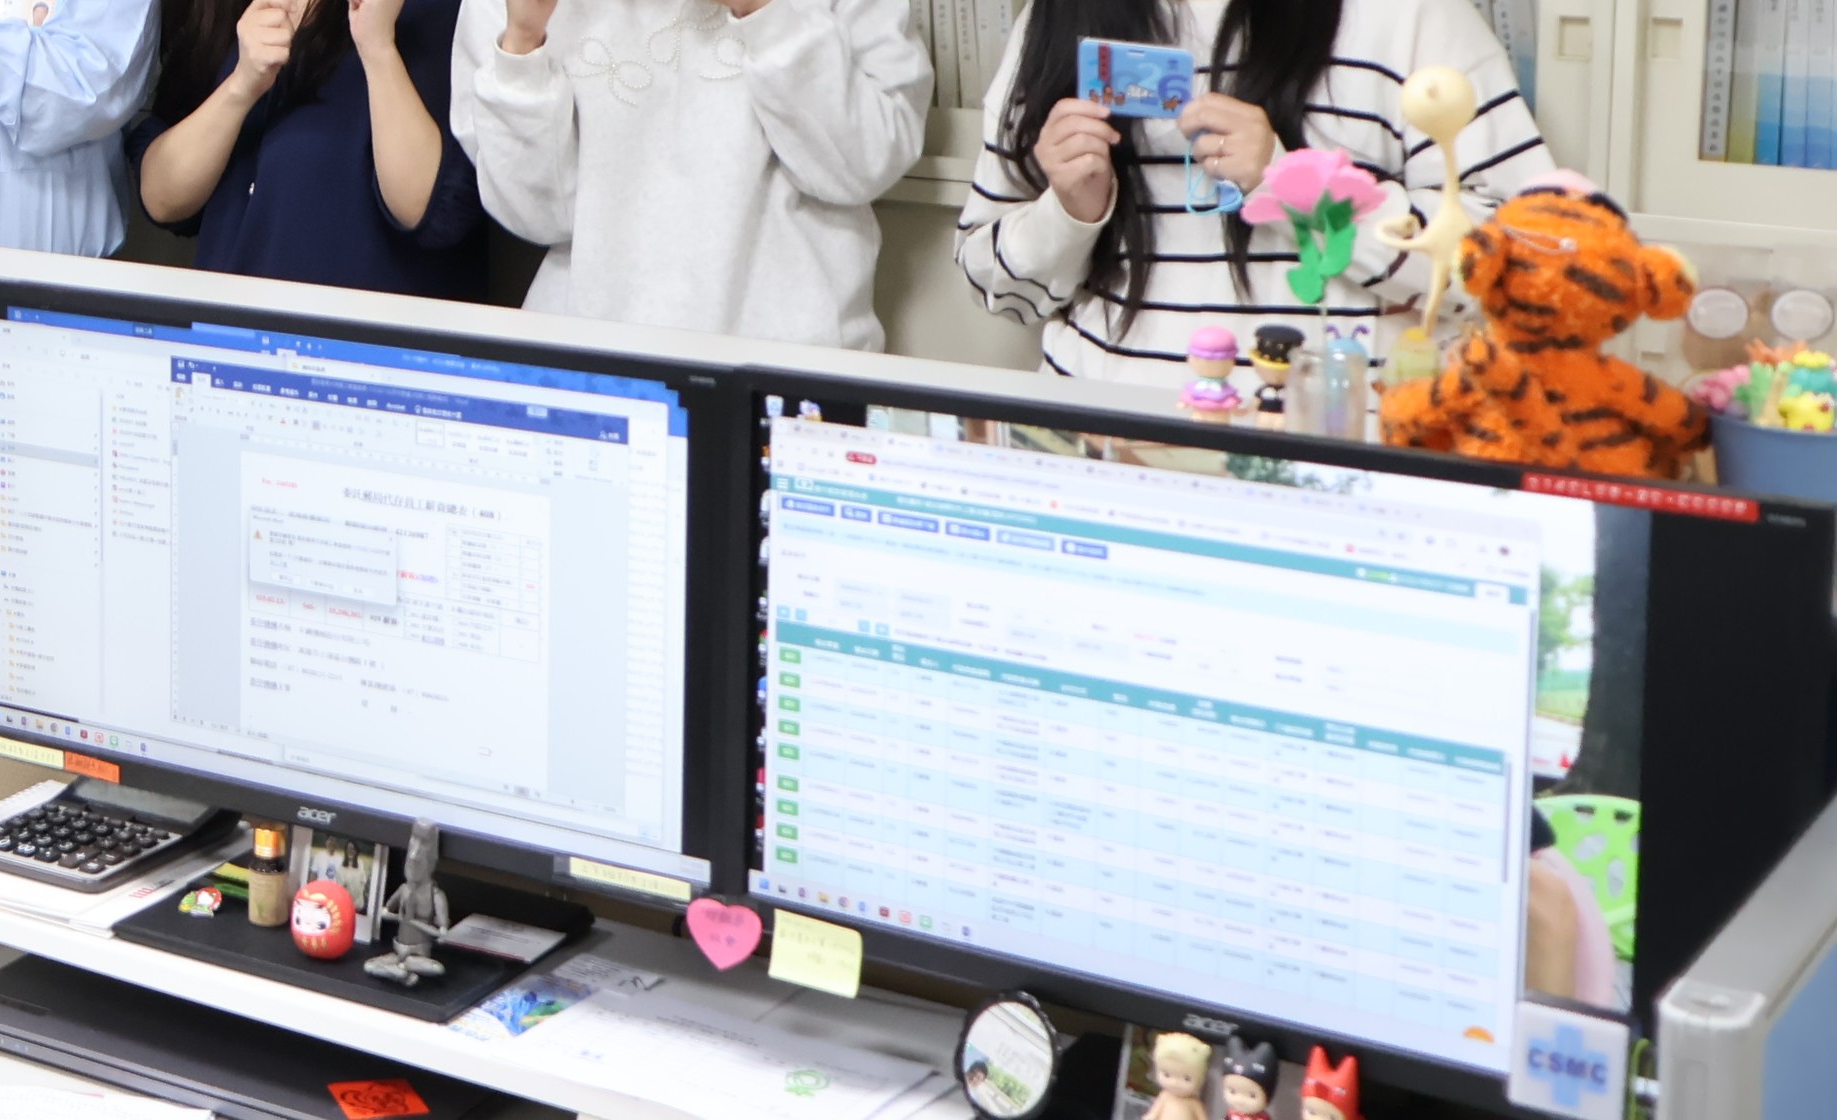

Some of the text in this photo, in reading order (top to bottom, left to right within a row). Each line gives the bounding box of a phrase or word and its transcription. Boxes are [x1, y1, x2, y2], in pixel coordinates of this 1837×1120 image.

[297, 806, 337, 825] acer
[1182, 1012, 1240, 1036] acer
[1527, 1047, 1607, 1086] CSMC
